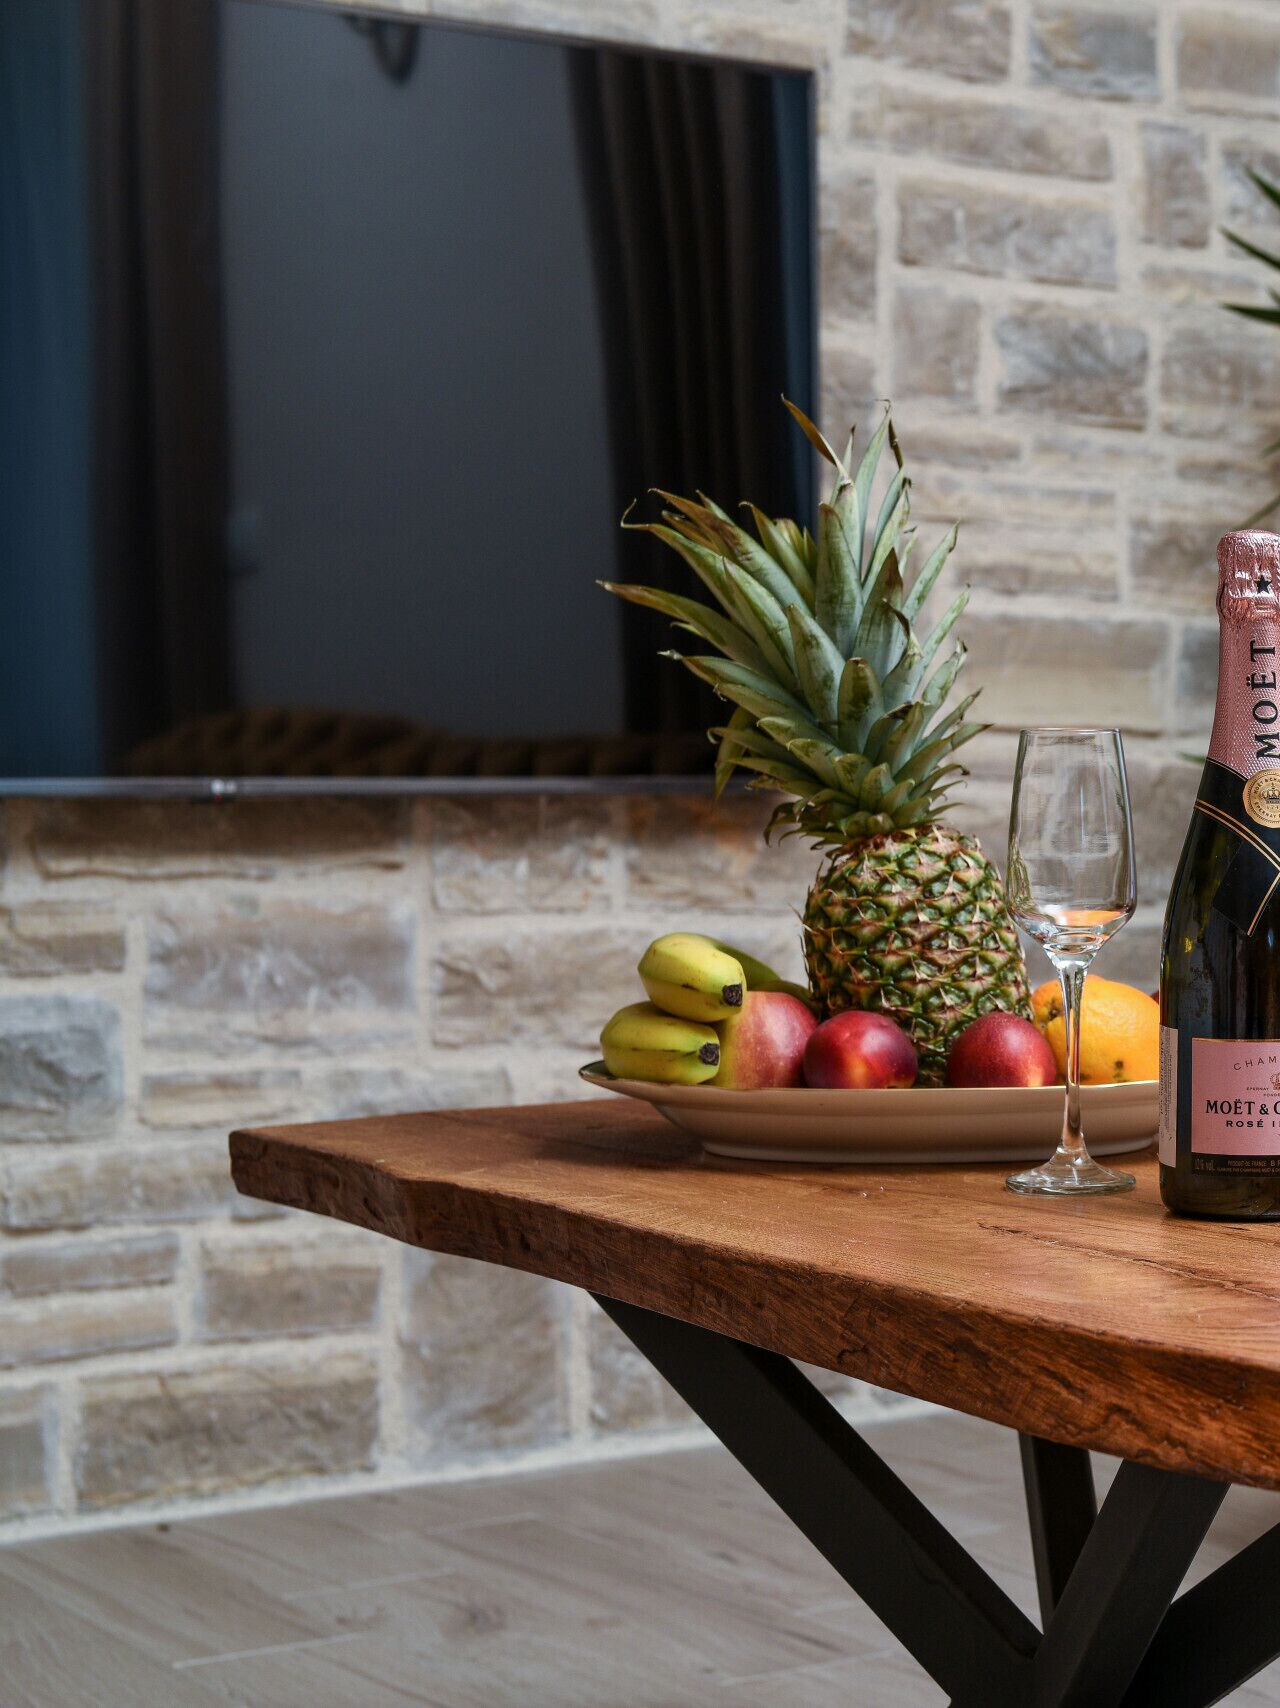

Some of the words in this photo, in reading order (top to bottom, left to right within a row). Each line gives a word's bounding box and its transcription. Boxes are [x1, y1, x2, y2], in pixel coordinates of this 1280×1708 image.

[1205, 1098, 1255, 1115] MOËT
[1259, 1103, 1269, 1115] &
[1226, 1119, 1264, 1128] ROSÉ
